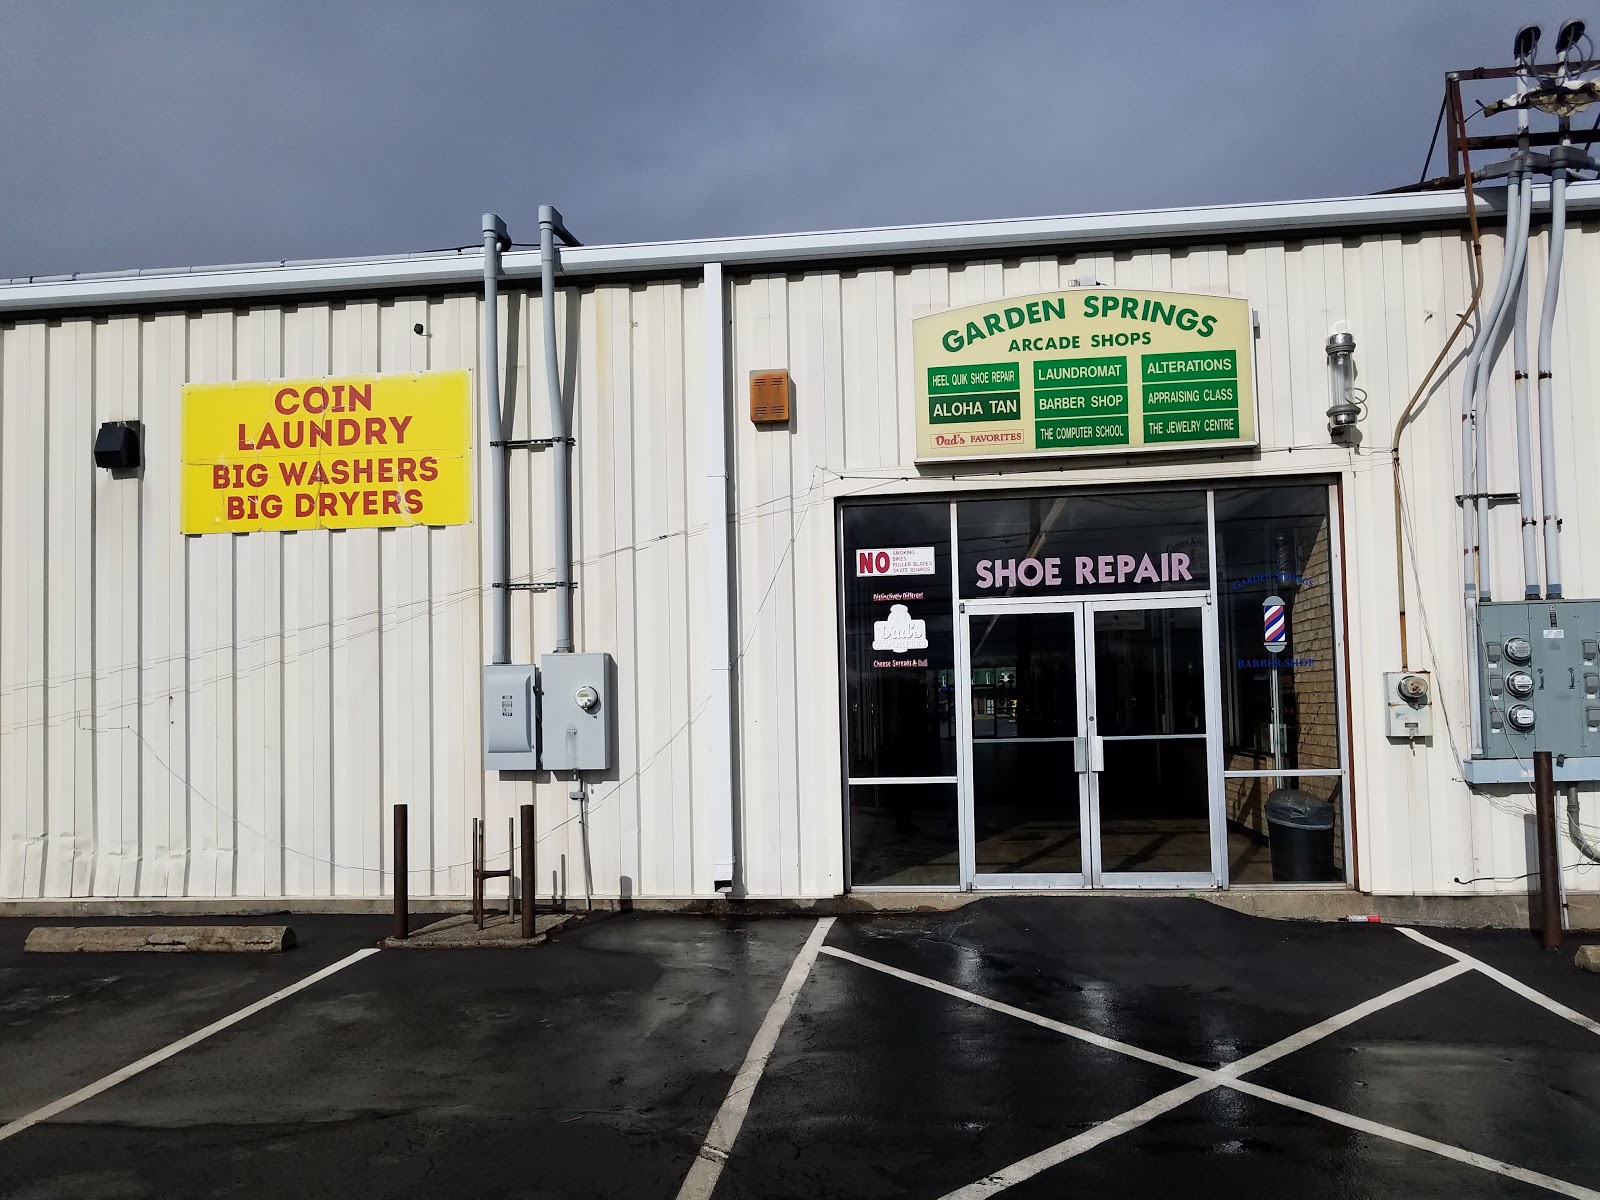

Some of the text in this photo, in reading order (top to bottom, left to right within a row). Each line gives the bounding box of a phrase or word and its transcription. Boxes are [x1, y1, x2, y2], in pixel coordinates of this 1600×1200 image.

[942, 295, 1218, 353] GARDEN SPRINGS
[1008, 332, 1151, 352] ARCADE SHOPS
[1038, 364, 1122, 381] LAUNDROMAT
[1147, 358, 1232, 374] ALTERATIONS
[932, 370, 1015, 387] HEEL QUIK SHOE REPAIR
[275, 383, 372, 416] COIN
[1039, 394, 1123, 411] BARBER SHOP
[1148, 388, 1233, 404] APPRAISING CLASS
[933, 399, 1017, 417] ALOHA TAN
[238, 416, 413, 451] LAUNDRY
[1040, 424, 1124, 441] THE COMPUTER SCHOOL
[1148, 418, 1234, 435] THE JEWELRY CENTRE
[935, 433, 1022, 446] Dad's FAVORITES
[213, 456, 439, 490] BIG WASHERS
[227, 489, 424, 520] BIG DRYERS
[859, 551, 891, 574] NO
[976, 552, 1193, 589] SHOE REPAIR
[1232, 571, 1272, 591] GARDEN
[873, 659, 891, 668] Cheese
[1238, 658, 1315, 669] BARBER SHOP
